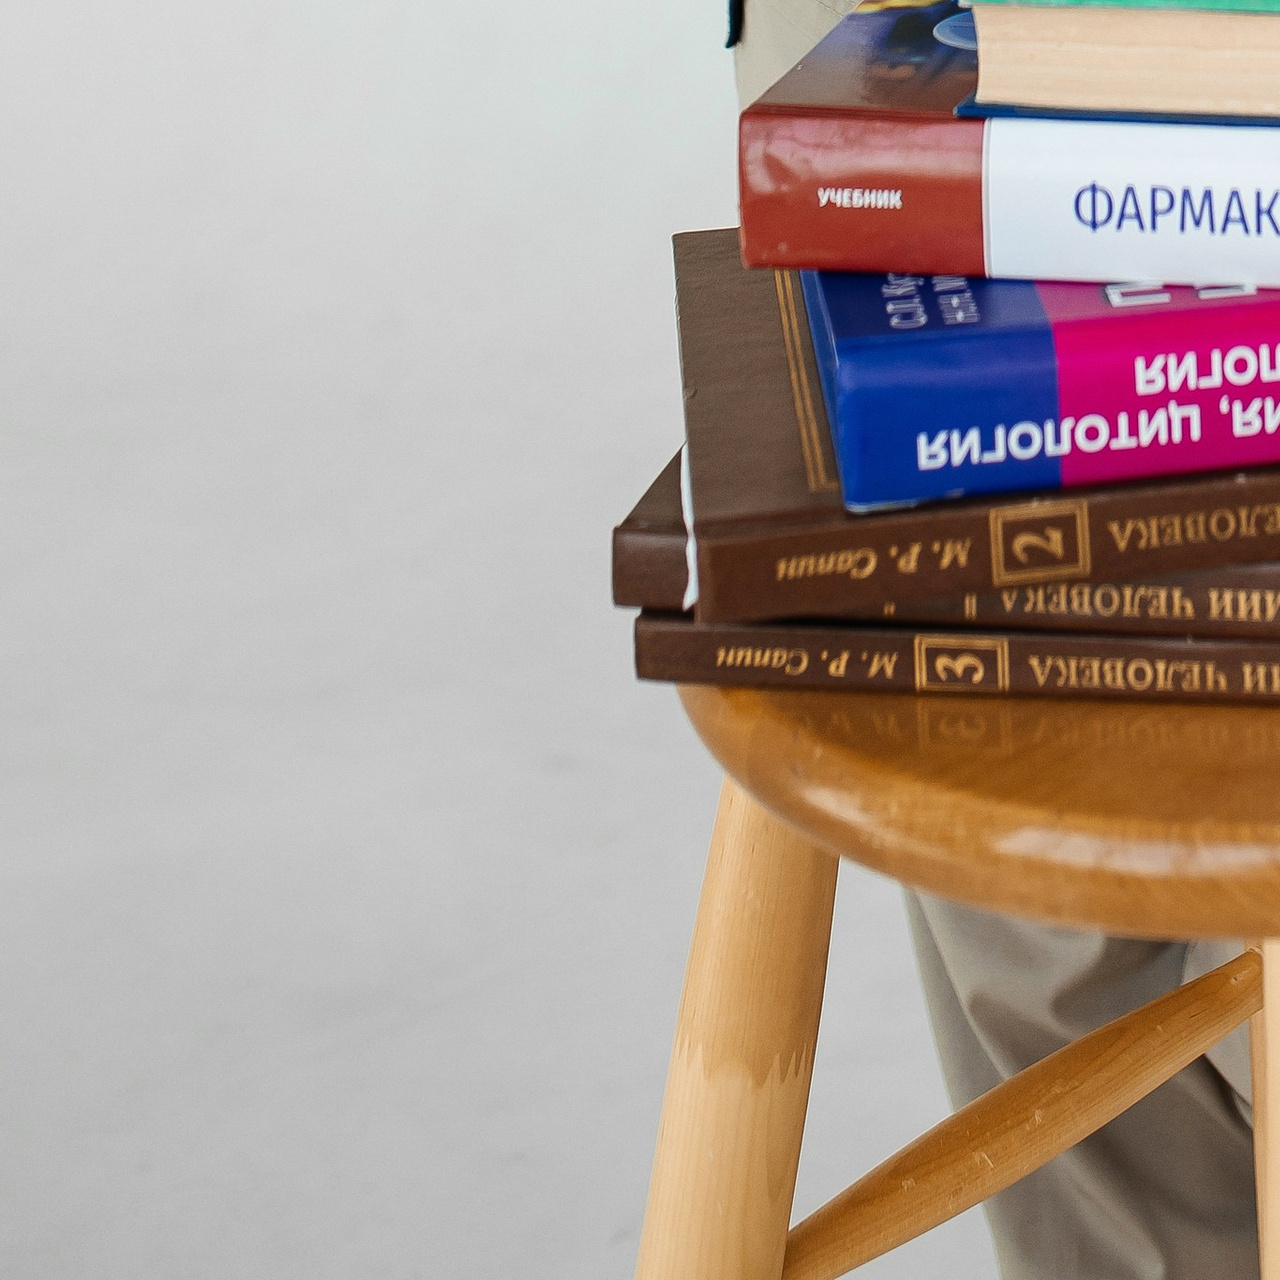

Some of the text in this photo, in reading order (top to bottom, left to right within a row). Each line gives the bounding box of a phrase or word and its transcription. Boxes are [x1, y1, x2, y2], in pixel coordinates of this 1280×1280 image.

[817, 187, 903, 209] УЧЕБНИК
[916, 399, 1201, 471] ЦИТОЛОГИЯ
[775, 538, 971, 581] М. Р. Сапин
[1010, 527, 1064, 563] 2
[1001, 584, 1195, 618] ЧЕЛОВЕКА
[715, 647, 898, 679] М. Р. Сапин
[934, 651, 987, 684] 3
[1028, 655, 1227, 692] ЧЕЛОВЕКА
